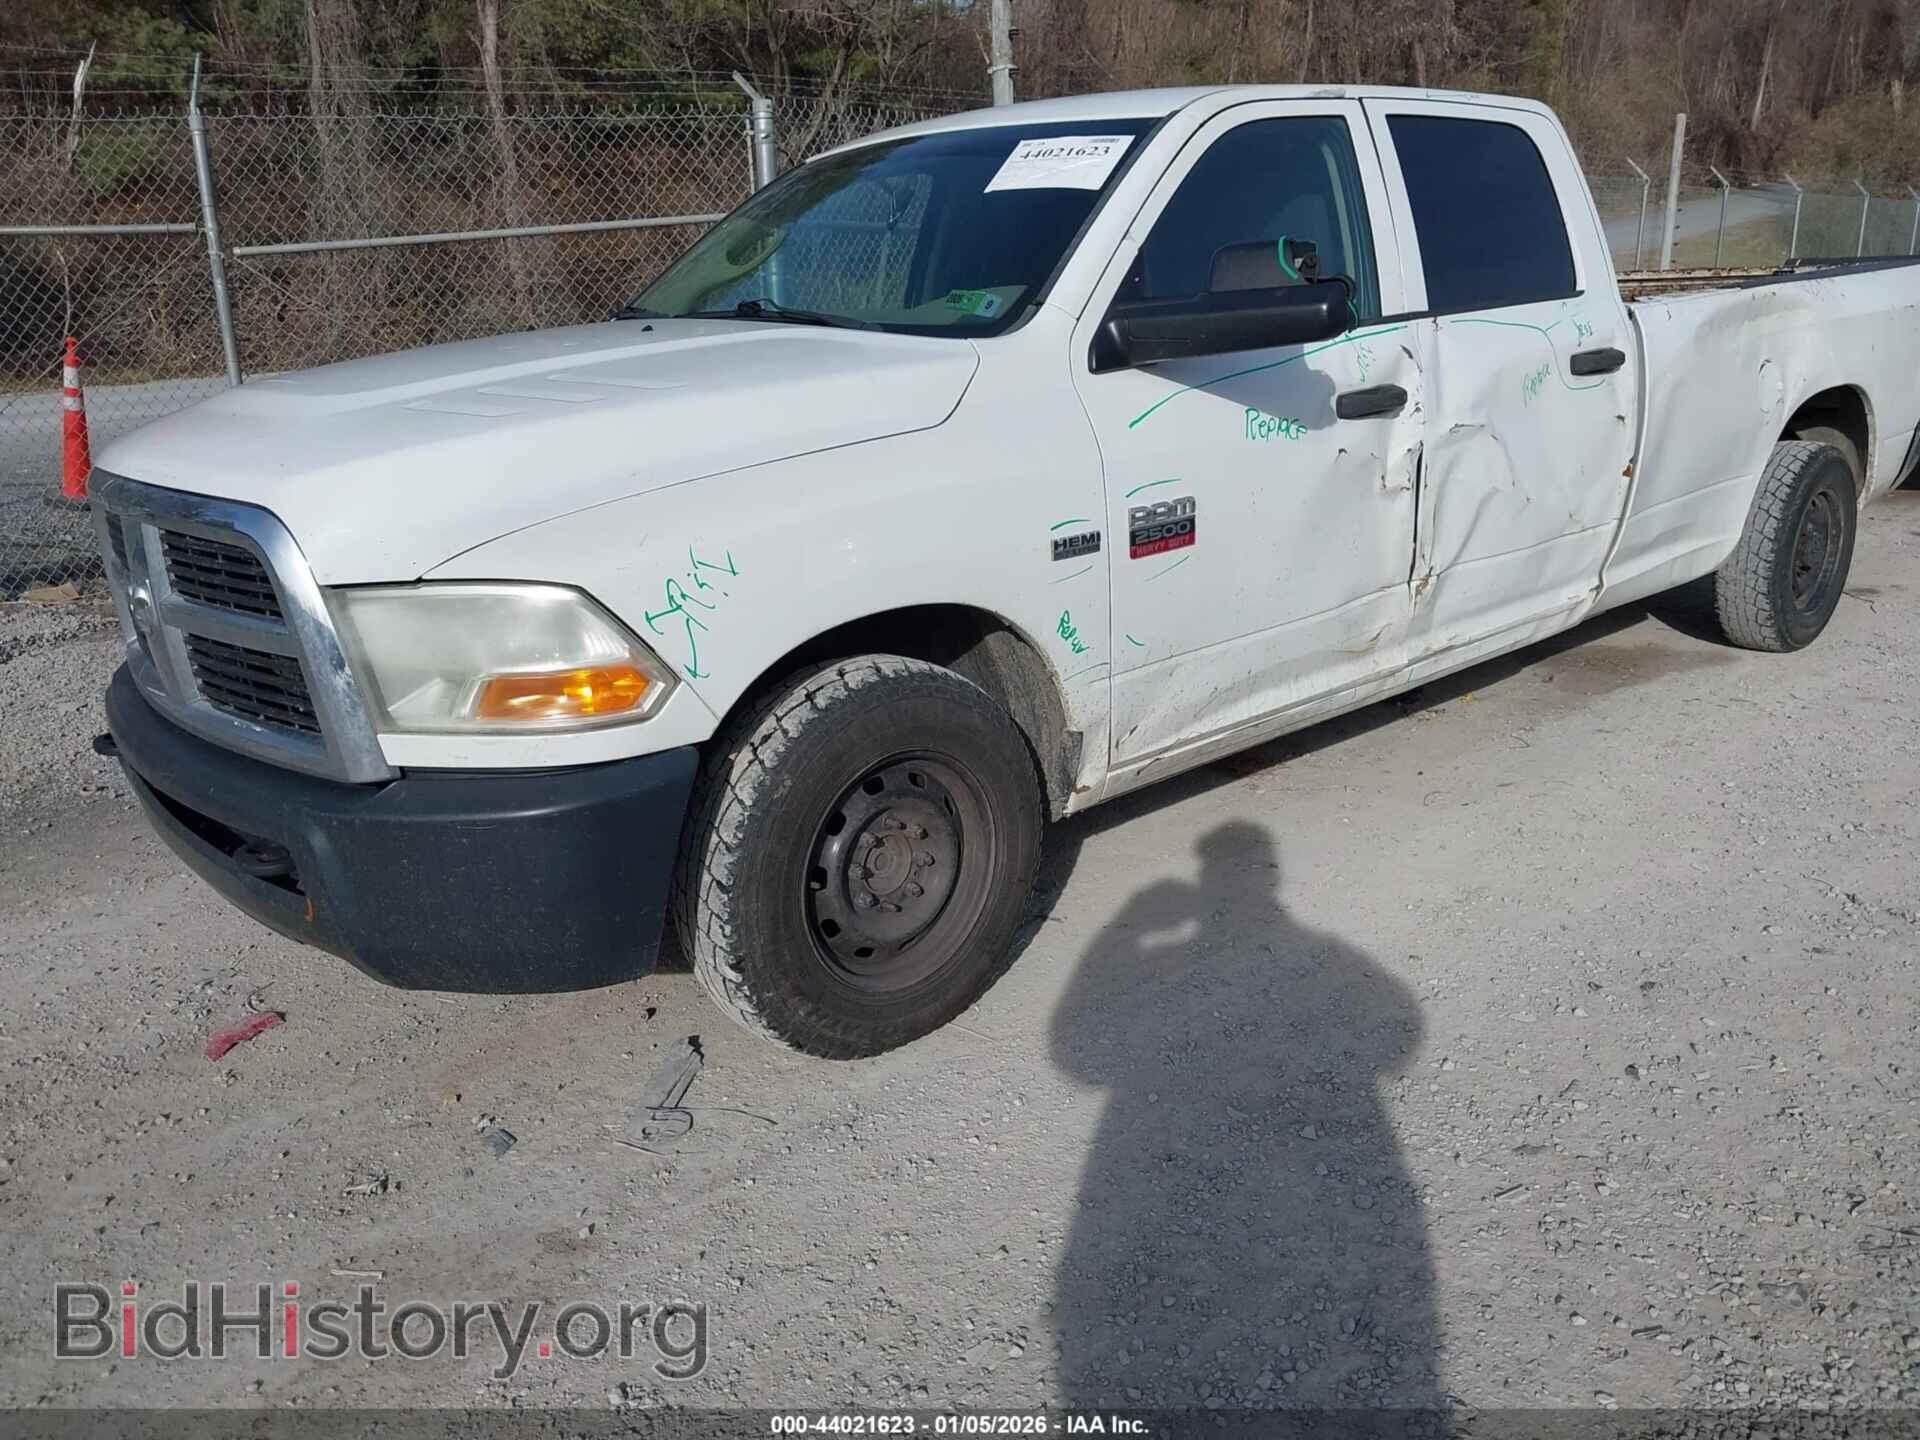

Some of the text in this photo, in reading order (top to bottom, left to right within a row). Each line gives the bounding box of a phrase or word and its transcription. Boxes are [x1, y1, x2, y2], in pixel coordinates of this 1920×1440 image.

[1020, 145, 1110, 161] 44021623
[1053, 530, 1101, 551] HEMI
[1135, 521, 1191, 544] 2500
